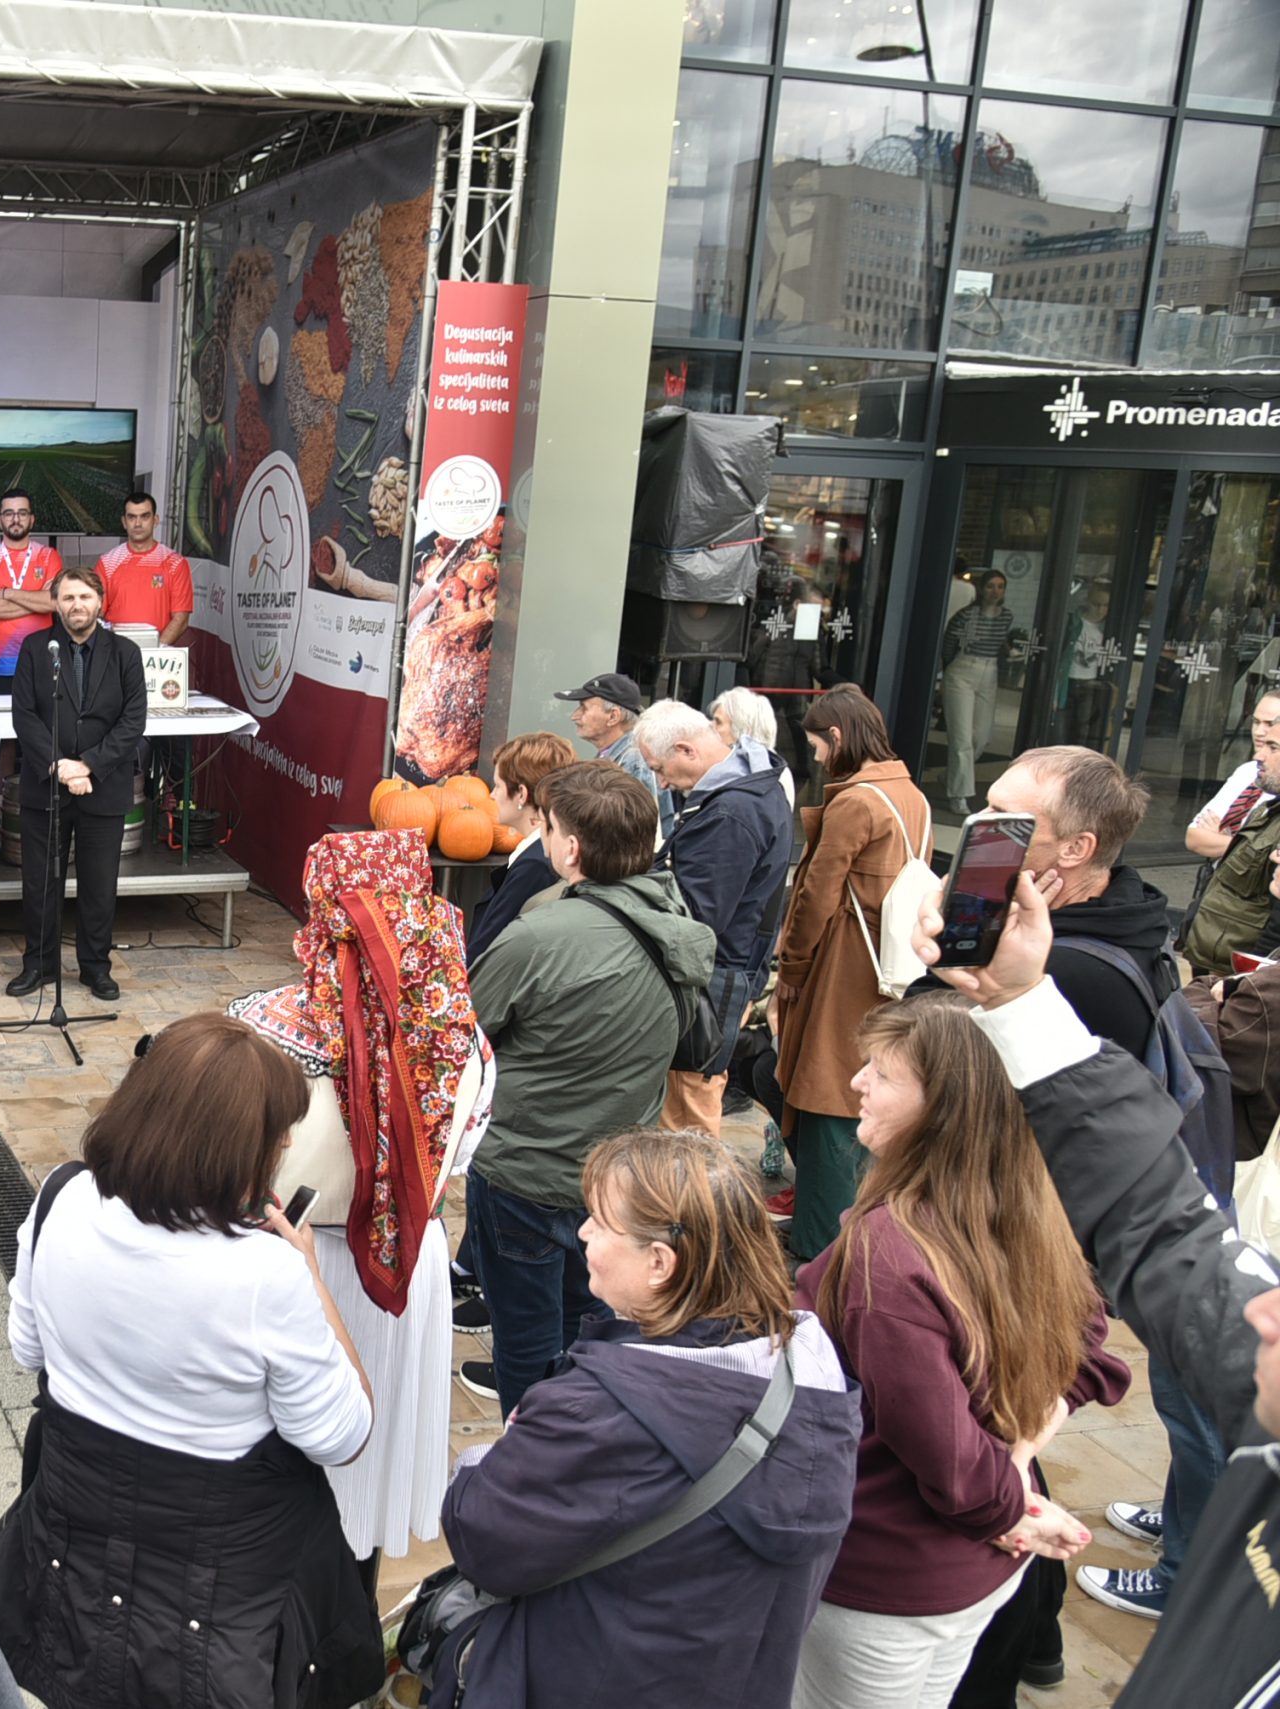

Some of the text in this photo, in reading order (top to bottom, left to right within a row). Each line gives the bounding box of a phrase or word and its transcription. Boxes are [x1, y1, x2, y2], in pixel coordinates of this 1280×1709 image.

[444, 323, 514, 347] Degustacija
[445, 347, 508, 367] kulinarskih
[439, 372, 509, 393] specijaliteta
[434, 395, 510, 416] iz celog sveta
[1106, 400, 1280, 427] Promenada
[237, 593, 261, 608] TASTE
[262, 592, 270, 608] OF
[270, 592, 297, 608] PLANET
[295, 763, 317, 797] celog
